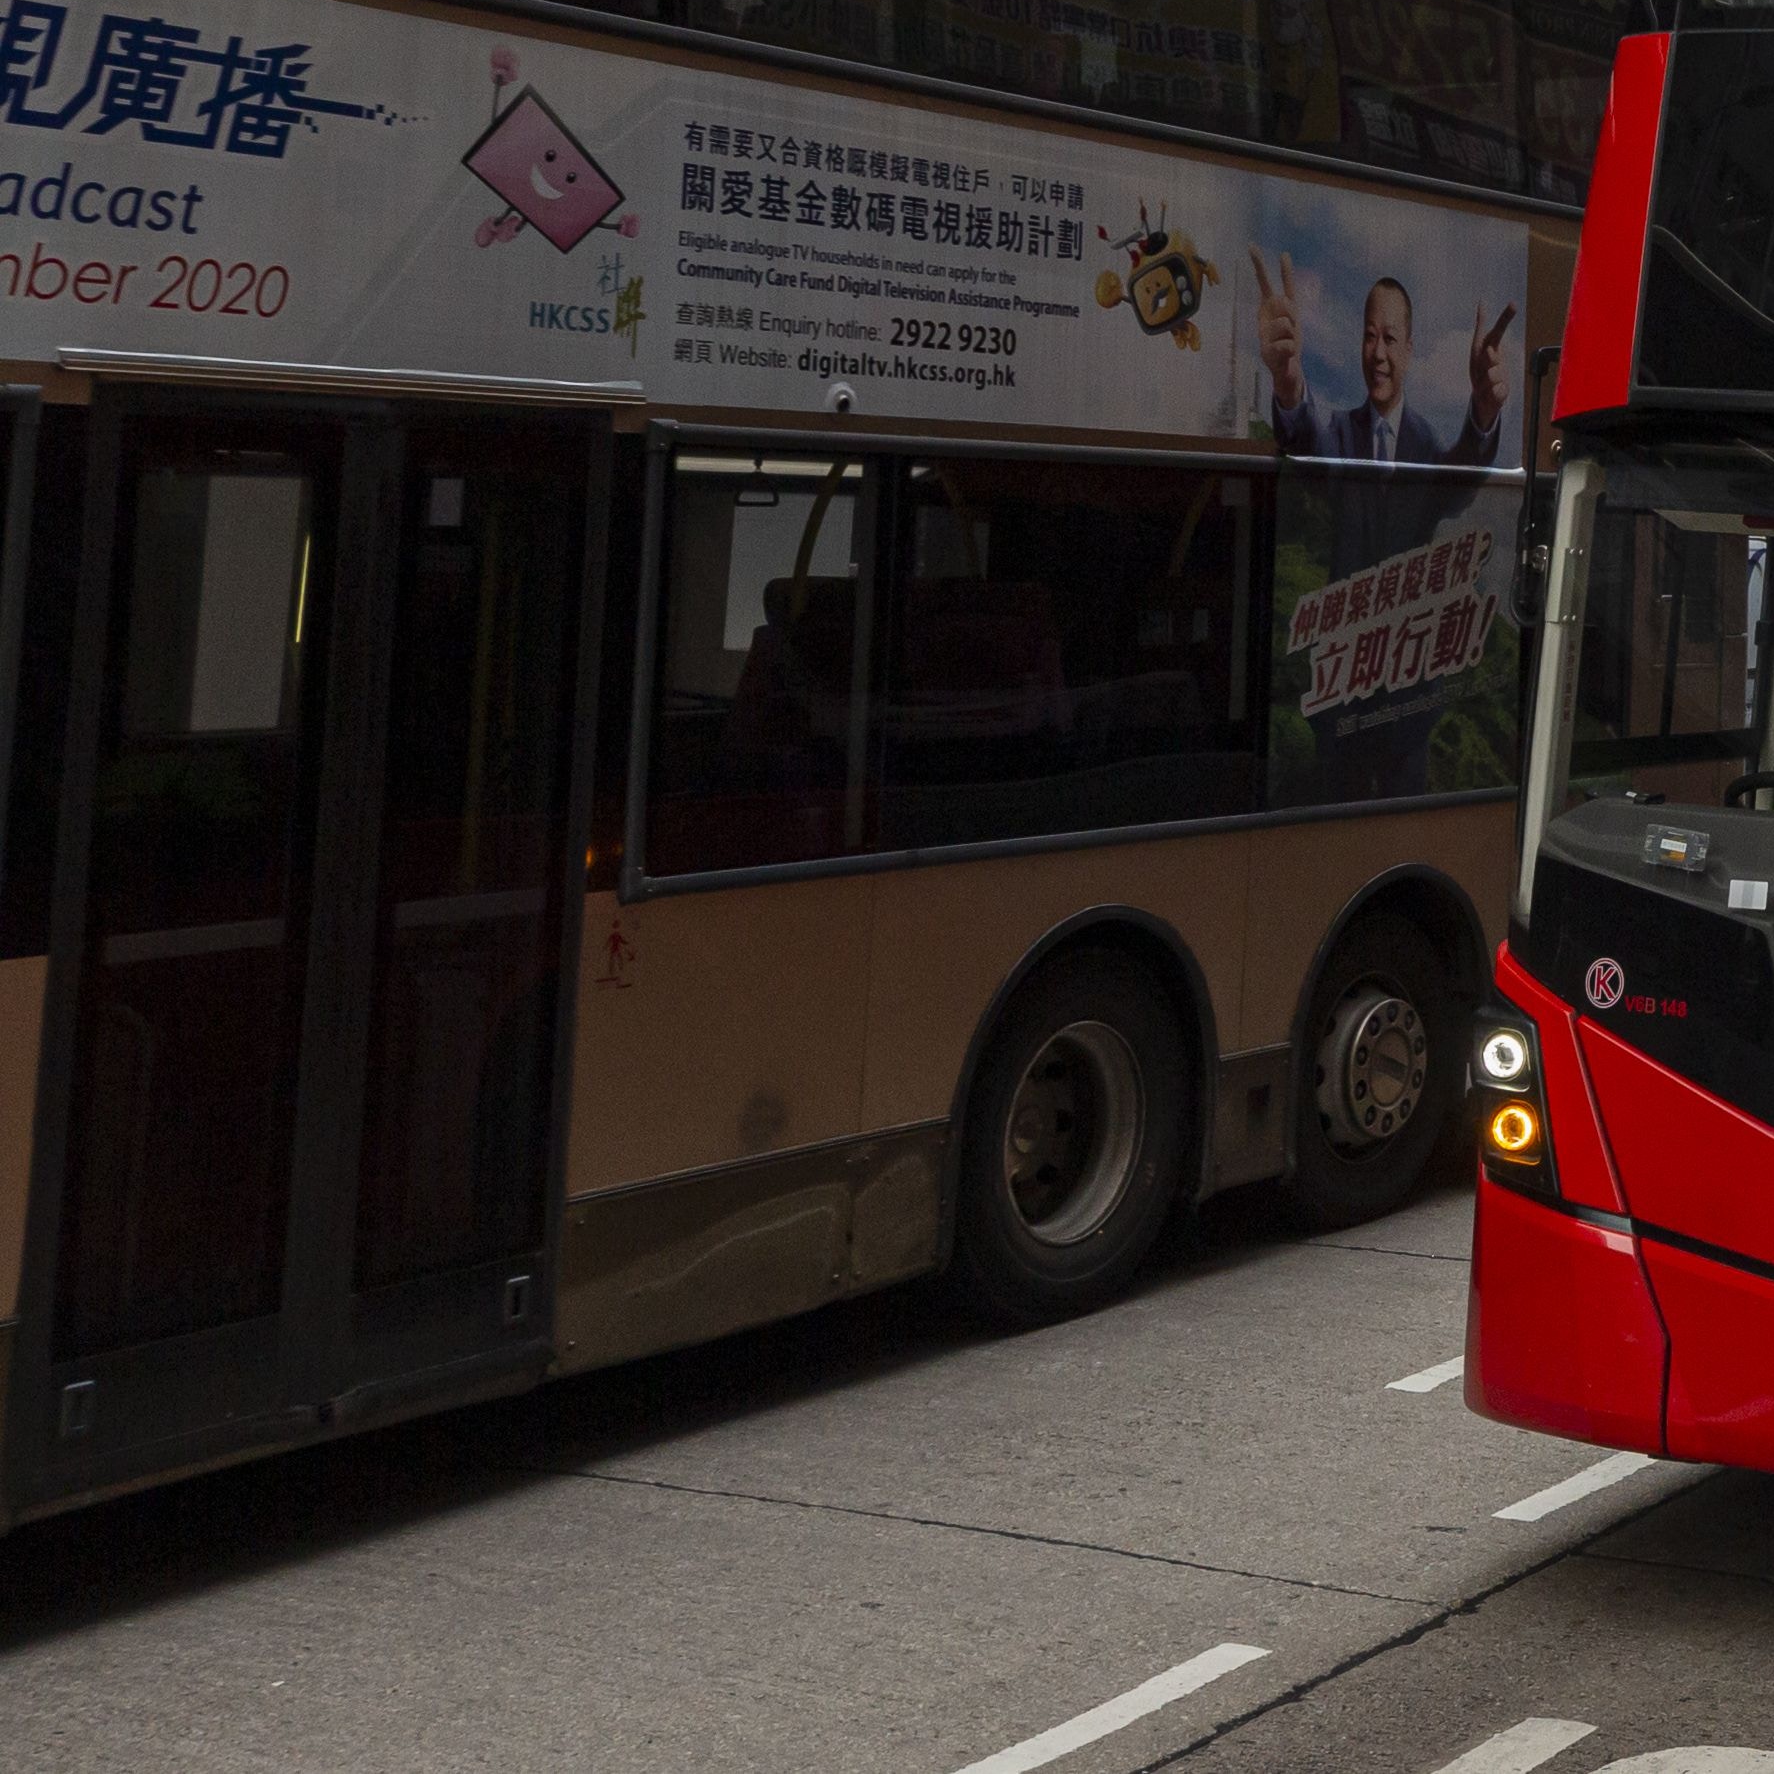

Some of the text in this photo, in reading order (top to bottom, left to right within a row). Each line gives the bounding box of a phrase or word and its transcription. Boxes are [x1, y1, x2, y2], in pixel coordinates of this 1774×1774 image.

[681, 163, 1083, 261] 關愛基金數碼電視援助計劃
[678, 230, 1016, 286] Eligible analogue TV households in need can apply for the
[150, 254, 291, 319] 2020
[676, 259, 1080, 319] Community Care Fund Digital Television Assistance Programme
[530, 301, 609, 334] HKCSS
[675, 302, 1016, 356] 查詢熱線 Enquiry hotline: 2922 9230
[719, 343, 792, 370] Website:
[797, 348, 1016, 390] digitaltv.hkcss.org.hk
[1305, 594, 1497, 708] 立即行動!
[1625, 996, 1656, 1014] V6B
